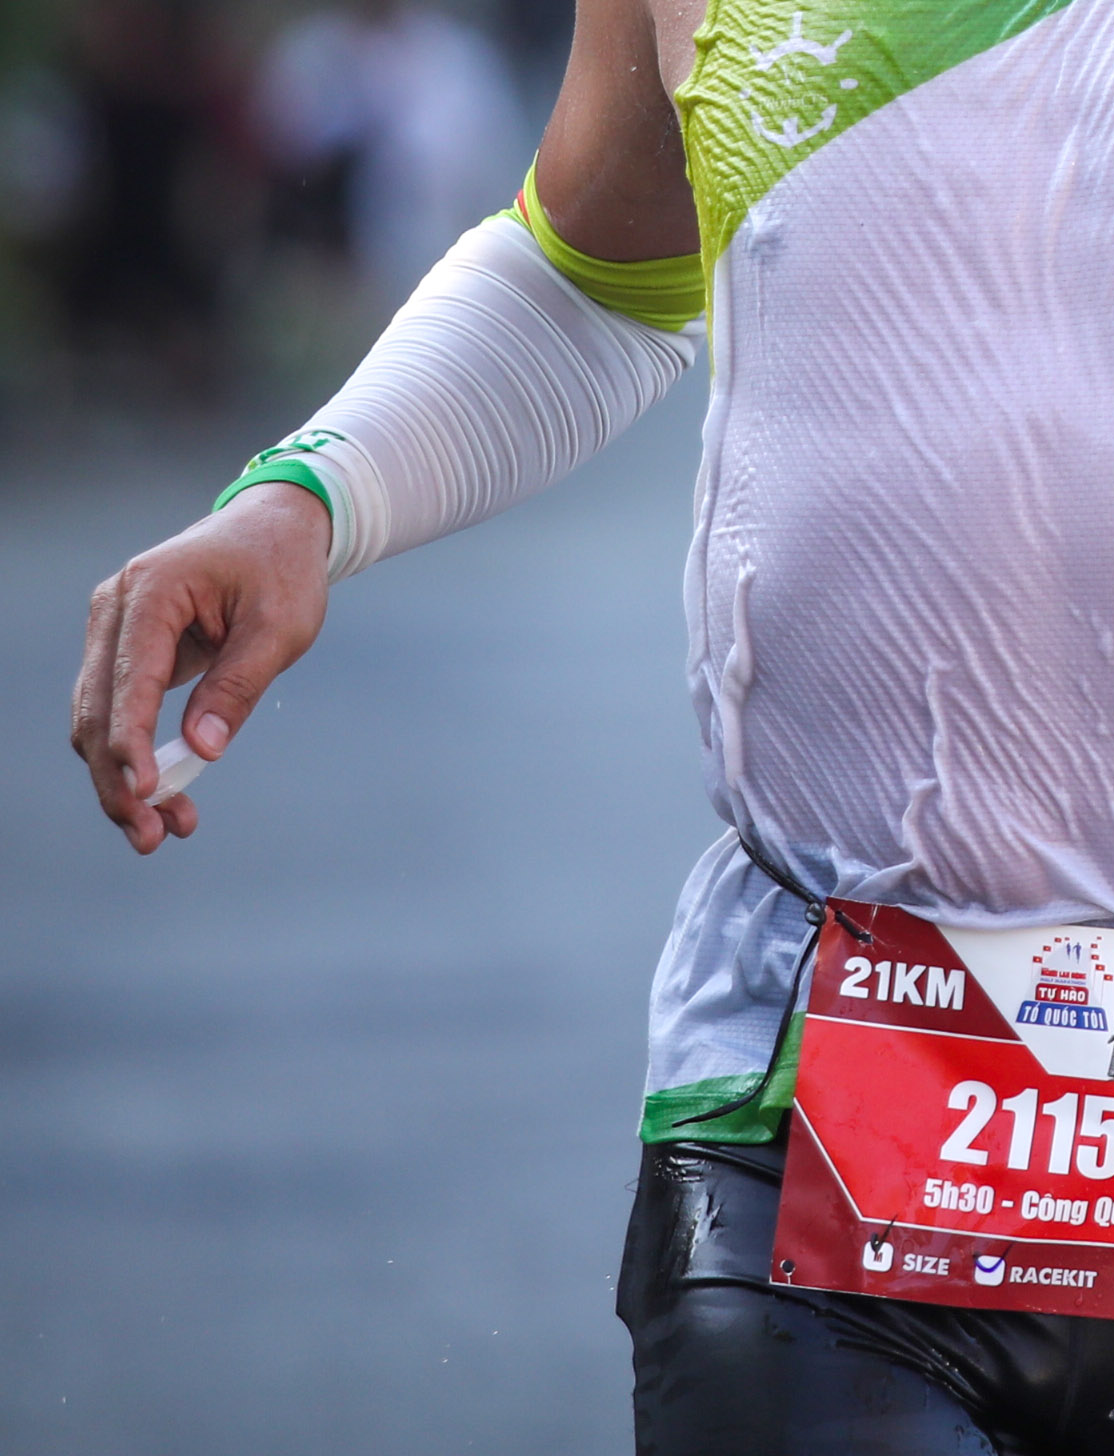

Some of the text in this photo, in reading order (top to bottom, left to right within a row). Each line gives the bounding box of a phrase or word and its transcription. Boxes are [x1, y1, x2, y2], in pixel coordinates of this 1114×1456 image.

[839, 953, 966, 1012] 21KM
[923, 1177, 995, 1215] 5h30
[1001, 1198, 1014, 1208] -
[1020, 1190, 1089, 1226] Công
[902, 1252, 950, 1276] SIZE
[1008, 1265, 1098, 1289] RACEKIT
